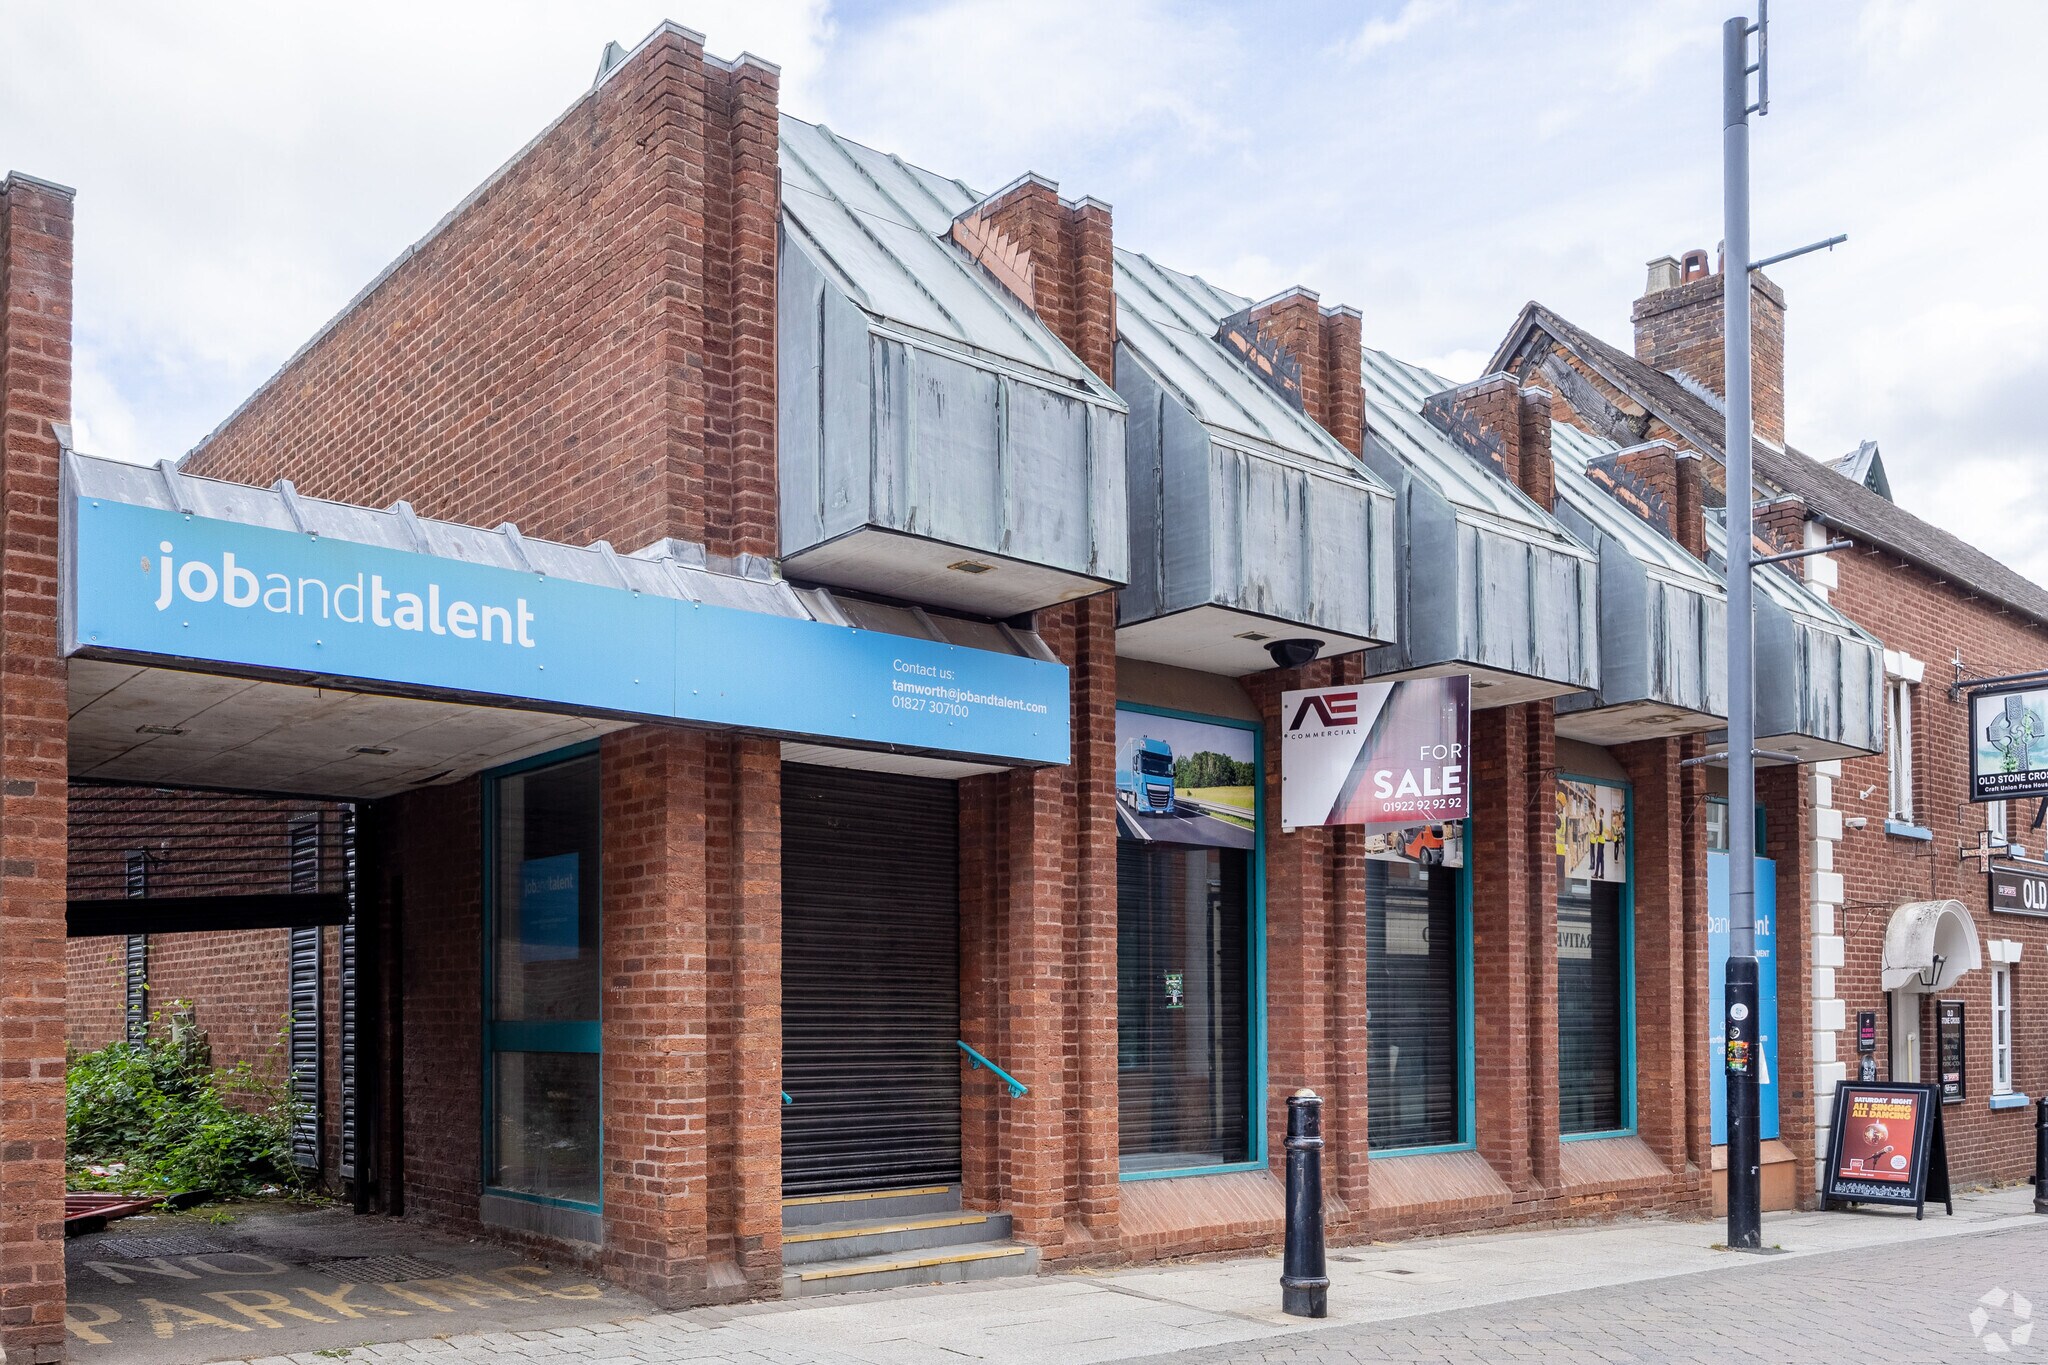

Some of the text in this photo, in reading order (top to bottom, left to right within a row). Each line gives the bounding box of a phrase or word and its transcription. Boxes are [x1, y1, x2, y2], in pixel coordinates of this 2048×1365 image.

[154, 540, 536, 648] jobandtalent
[893, 659, 955, 680] Contact us:
[892, 679, 1047, 714] tamworth@jobandtalent.com
[892, 695, 969, 718] 01827 307100
[1291, 729, 1357, 740] COMMERCIAL
[1420, 743, 1462, 761] FOR
[1373, 765, 1462, 800] SALE
[1978, 771, 2048, 785] OLD STONE CRO
[1383, 798, 1462, 812] 01922 92 92 92
[2023, 878, 2047, 910] OLD
[1852, 1110, 1911, 1120] ALL DANCING
[1853, 1103, 1912, 1113] ALL SINGING
[84, 1253, 292, 1284] NO
[65, 1266, 603, 1344] PARKING
